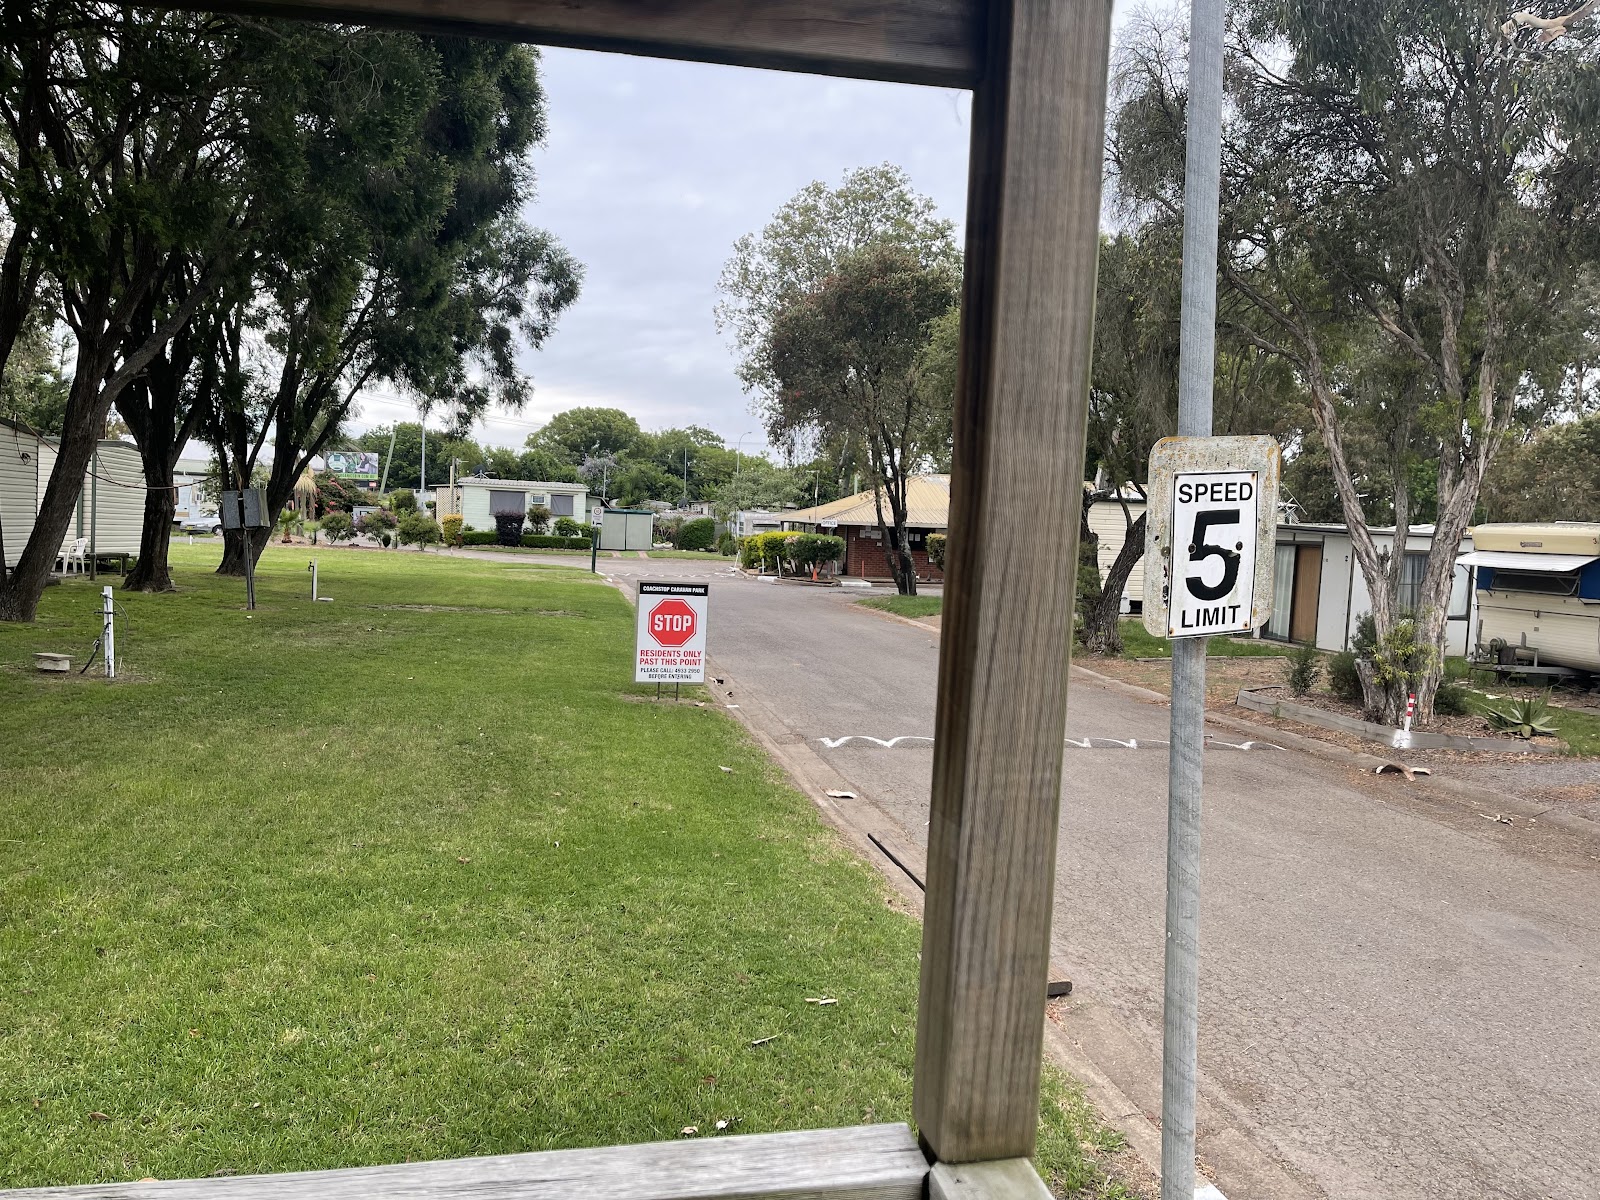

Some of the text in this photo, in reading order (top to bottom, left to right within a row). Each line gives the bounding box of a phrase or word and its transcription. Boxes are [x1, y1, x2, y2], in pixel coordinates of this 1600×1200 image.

[1178, 482, 1253, 504] SPEED
[1185, 508, 1241, 601] 5
[654, 614, 692, 632] STOP
[1181, 605, 1241, 629] LIMIT
